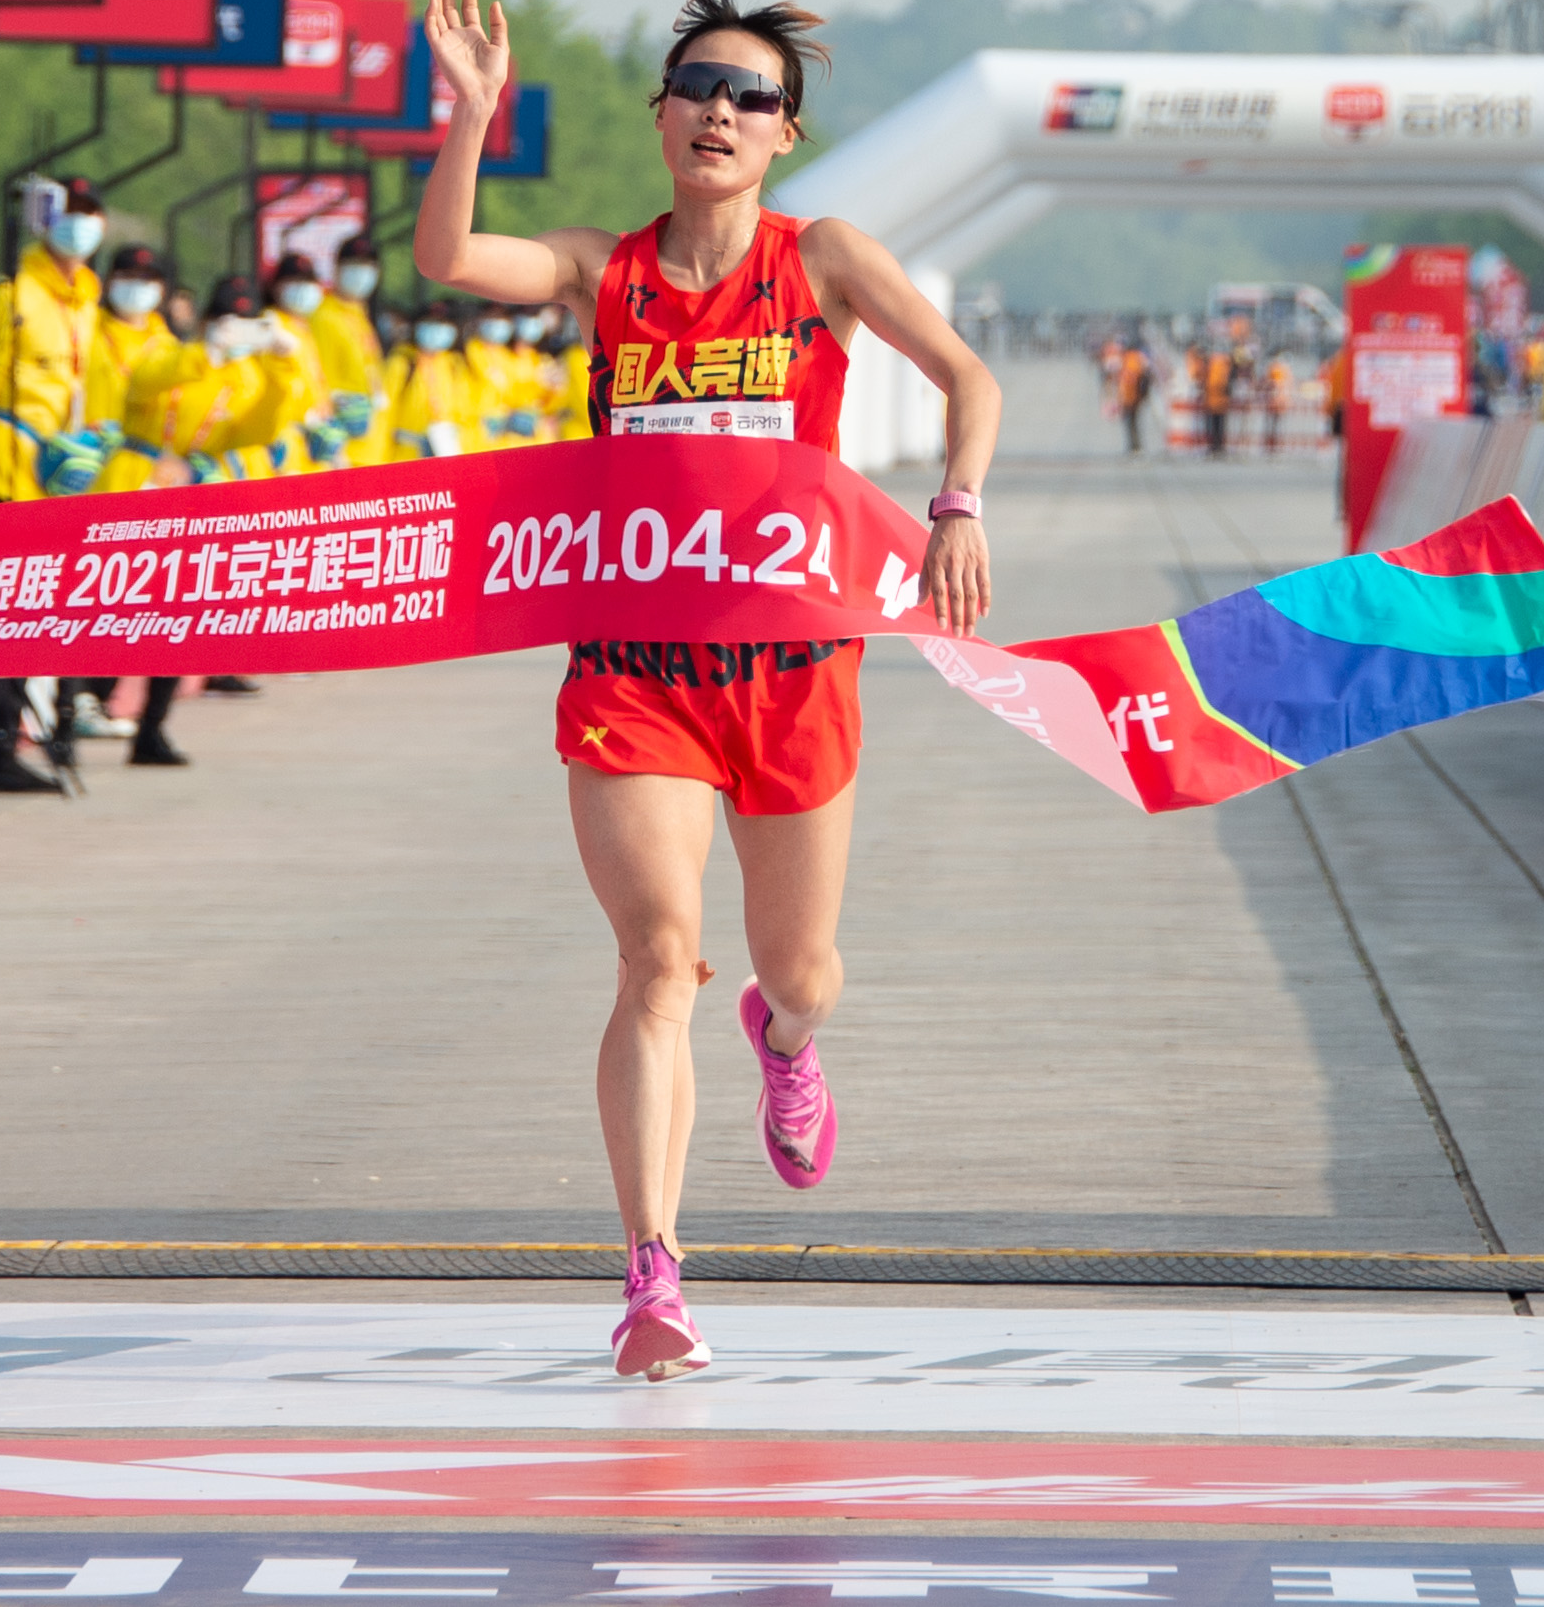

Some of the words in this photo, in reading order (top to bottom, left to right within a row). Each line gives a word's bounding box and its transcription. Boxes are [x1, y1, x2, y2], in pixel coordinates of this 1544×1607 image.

[737, 415, 782, 429] 云闪付
[82, 517, 186, 544] 北京国际长跑节
[187, 507, 319, 537] INTERNATIONAL
[319, 498, 387, 524] RUNNING
[387, 491, 456, 518] FESTIVAL
[65, 518, 455, 607] 2021北京半程马拉松
[89, 611, 194, 645] Beijing
[195, 605, 262, 635] Half
[261, 600, 387, 634] Marathon
[391, 588, 446, 624] 2021
